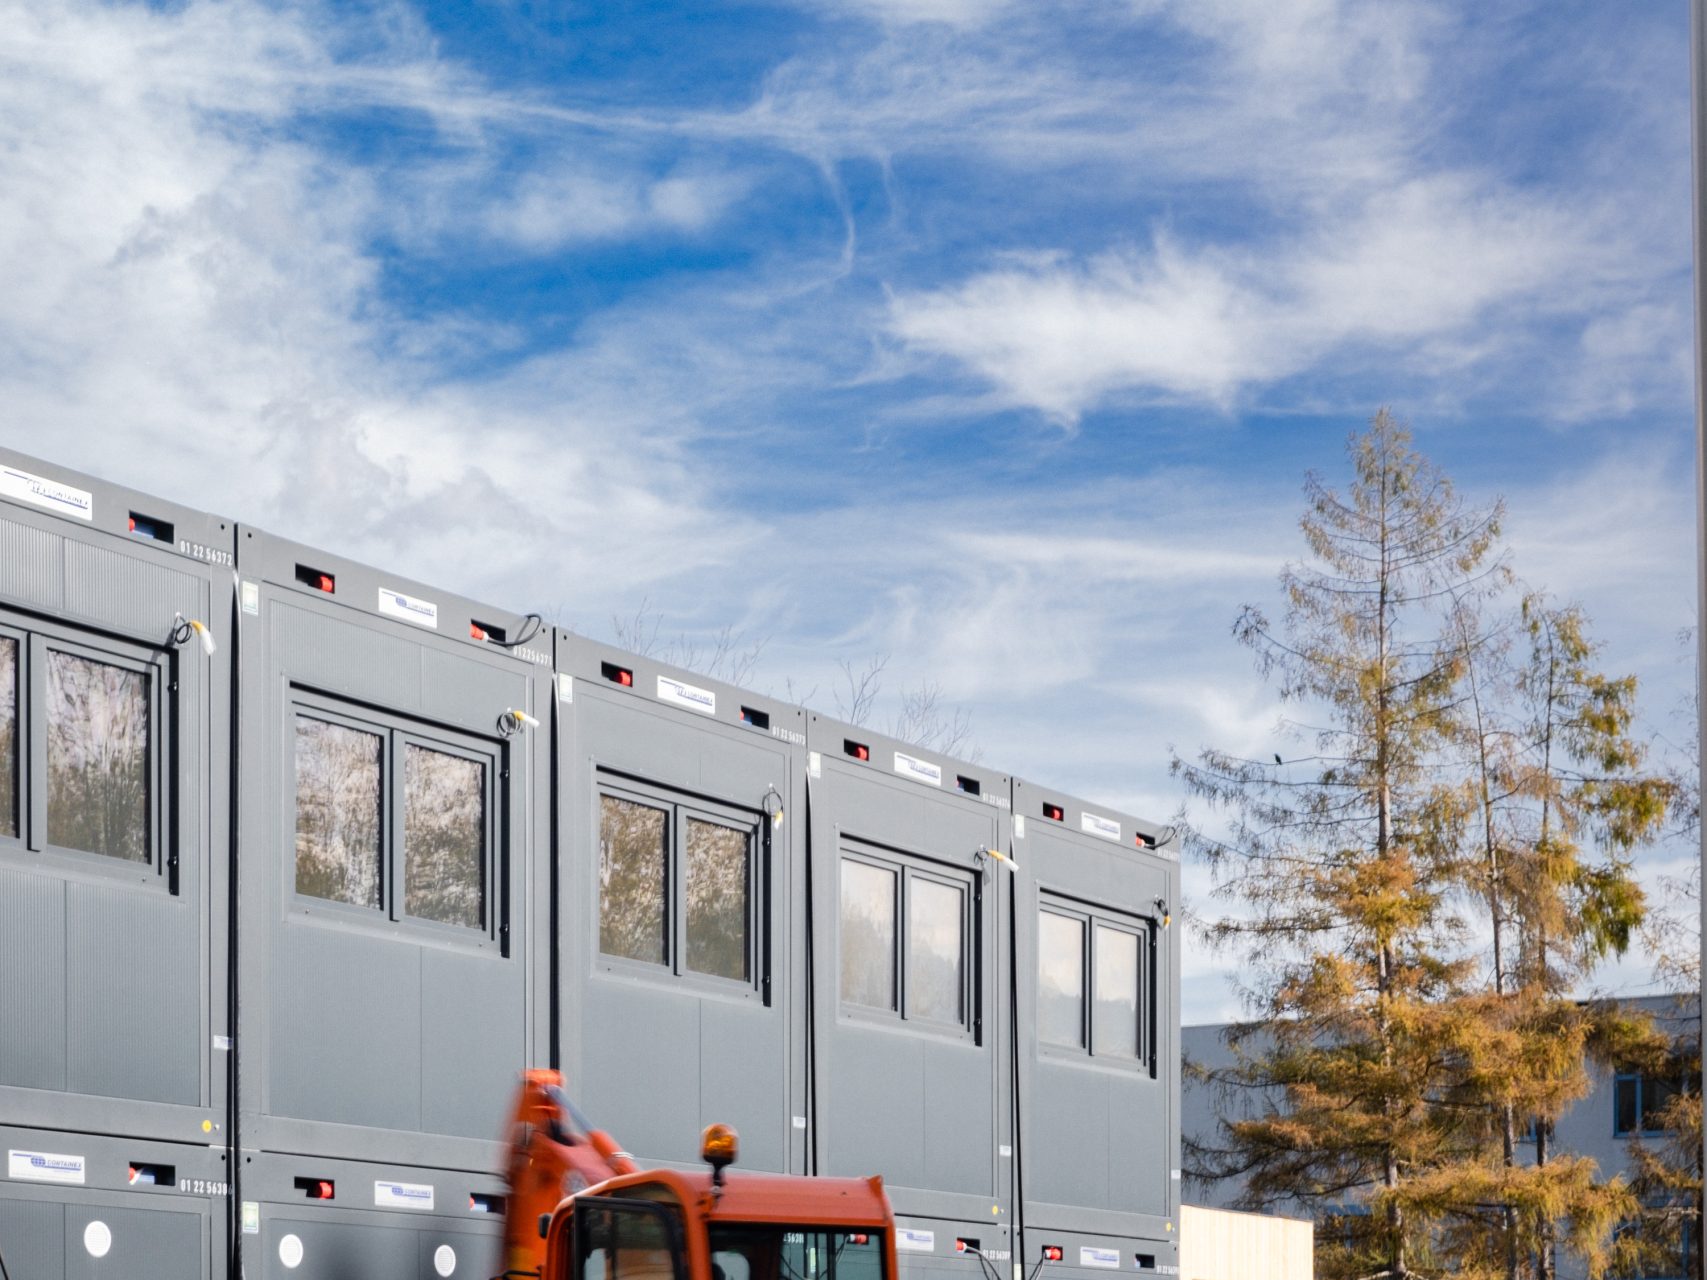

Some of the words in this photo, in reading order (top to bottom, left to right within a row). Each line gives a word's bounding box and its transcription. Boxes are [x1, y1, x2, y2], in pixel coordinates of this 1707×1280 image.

[180, 540, 191, 555] 01
[193, 544, 204, 559] 22
[205, 547, 233, 567] 56372
[180, 1179, 191, 1192] 01
[193, 1180, 205, 1194] 22
